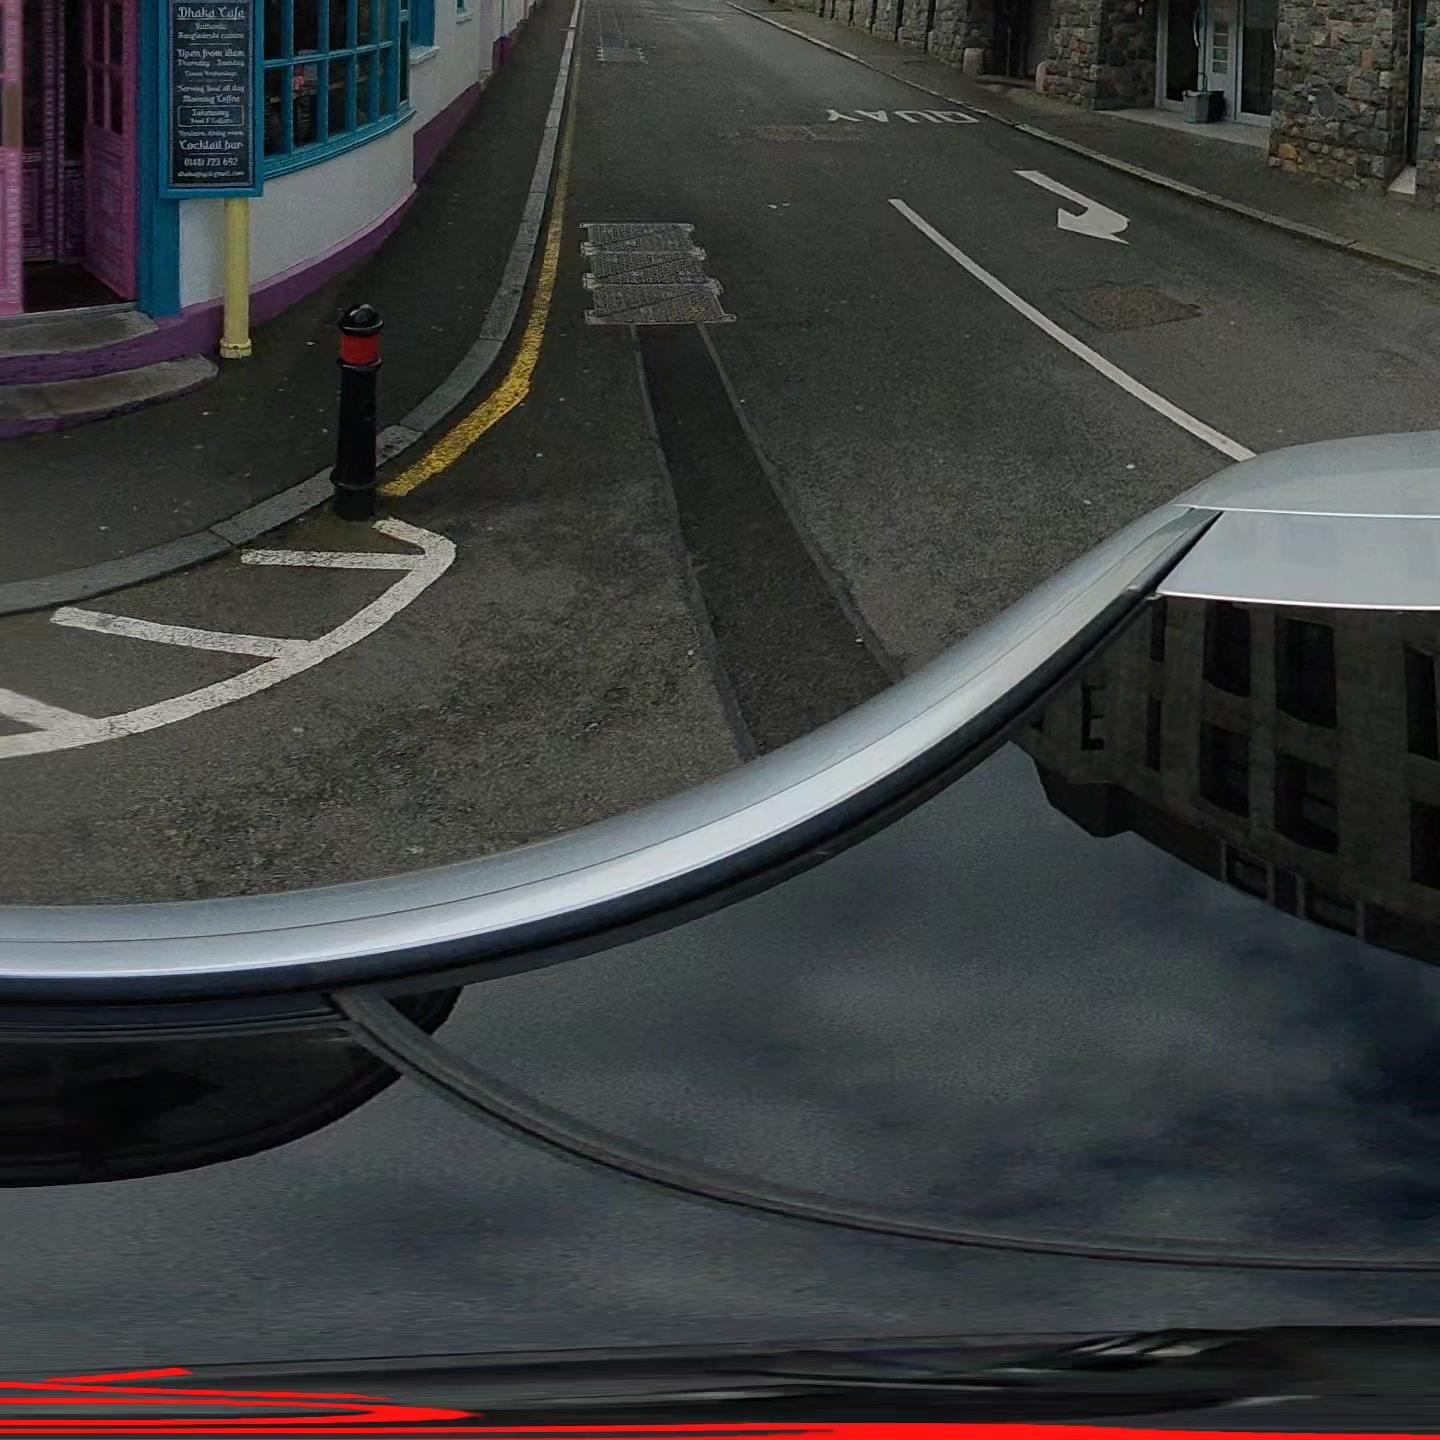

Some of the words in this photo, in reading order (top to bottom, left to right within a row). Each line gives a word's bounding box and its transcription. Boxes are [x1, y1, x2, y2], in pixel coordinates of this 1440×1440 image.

[177, 7, 215, 18] Dhaka
[179, 140, 223, 150] Cocktail
[224, 140, 244, 150] bar
